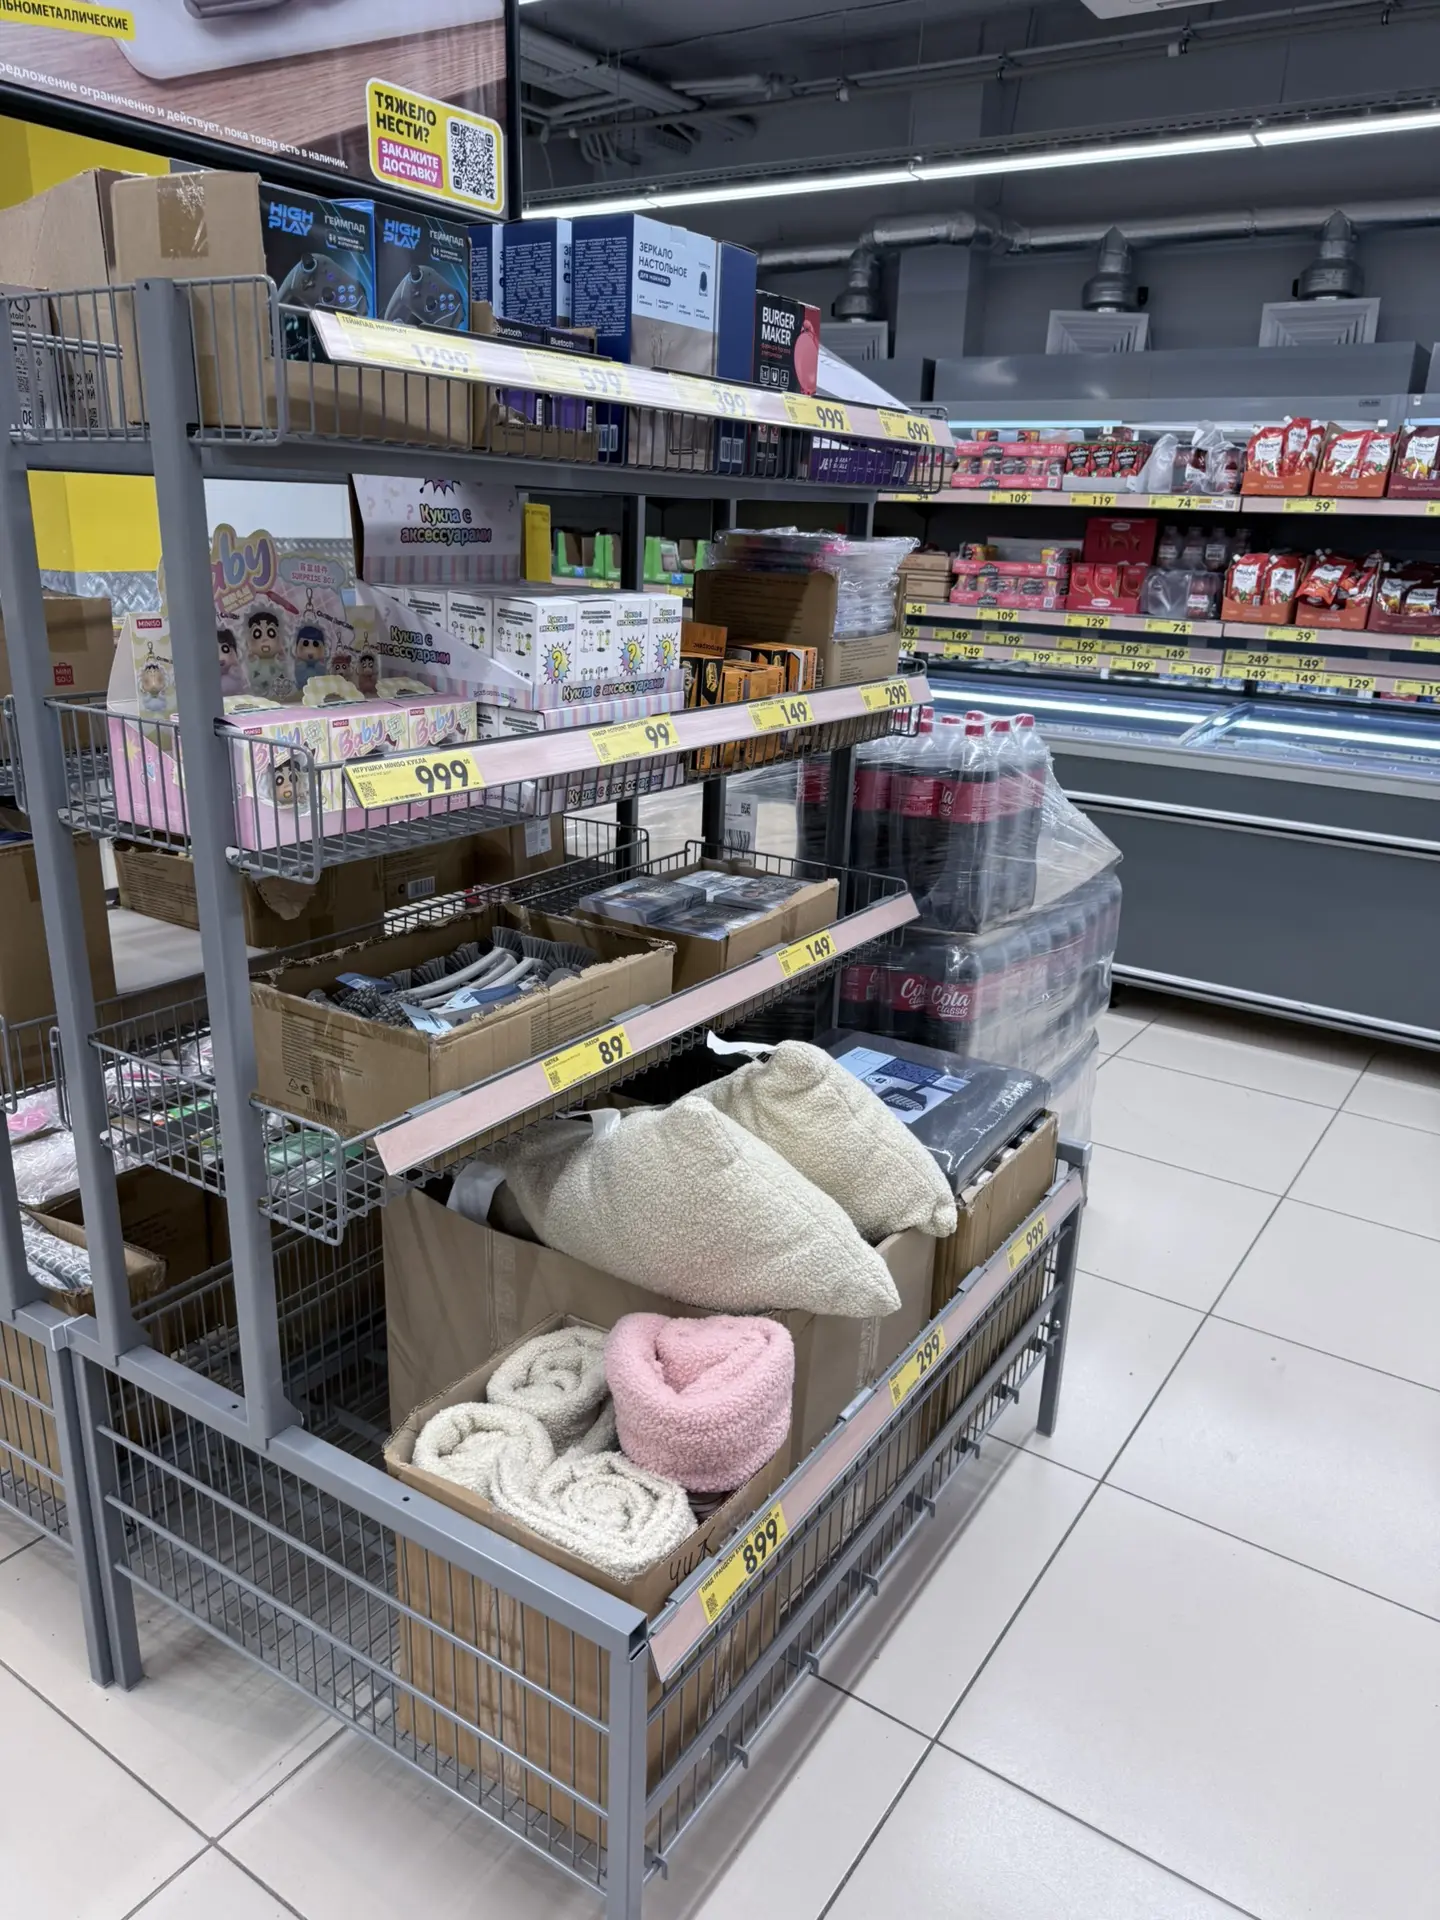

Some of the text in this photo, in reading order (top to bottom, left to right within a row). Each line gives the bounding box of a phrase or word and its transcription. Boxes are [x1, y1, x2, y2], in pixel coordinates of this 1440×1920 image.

[375, 90, 437, 127] ТЯЖЕЛО
[80, 83, 155, 115] ограниченно
[157, 107, 166, 117] и
[167, 110, 223, 137] действует,
[224, 127, 249, 142] пока
[250, 134, 279, 152] товар
[279, 142, 301, 157] есть
[302, 148, 308, 158] в
[308, 150, 349, 170] наличии.
[376, 112, 430, 144] НЕСТИ?
[381, 141, 439, 169] ЗАКАЖИТЕ
[383, 157, 438, 184] ДОСТАВКУ
[269, 202, 314, 222] HIGH
[268, 215, 313, 237] PLAY
[324, 215, 366, 235] ГЕЙМПАД
[384, 218, 421, 238] HIGH
[383, 231, 420, 250] PLAY
[429, 230, 464, 248] ГЕЙМПАД
[639, 241, 673, 260] ЗЕРКАЛО
[638, 256, 688, 278] НАСТОЛЬНОЕ
[762, 306, 795, 330] BURGER
[551, 337, 574, 349] Bluetooth
[761, 324, 791, 346] MAKER
[712, 389, 746, 417] 399
[816, 405, 844, 430] 999
[907, 421, 929, 442] 699
[1009, 493, 1027, 503] 109
[1092, 496, 1111, 506] 119
[1178, 498, 1191, 508] 74
[1315, 501, 1330, 512] 59
[419, 503, 472, 526] Кукла с
[400, 527, 492, 546] аксессуарами
[291, 572, 321, 584] SURPRISE
[912, 605, 922, 614] 54
[997, 611, 1014, 621] 109
[137, 619, 161, 628] MINISO
[1086, 617, 1104, 628] 129
[1173, 623, 1186, 633] 74
[390, 625, 423, 645] Кукла
[951, 631, 968, 641] 149
[1003, 635, 1020, 645] 199
[1296, 631, 1311, 642] 59
[964, 646, 980, 656] 149
[1077, 641, 1094, 651] 199
[1121, 645, 1139, 655] 199
[1166, 649, 1185, 659] 149
[1033, 653, 1050, 663] 199
[1075, 655, 1093, 665] 199
[1131, 661, 1150, 671] 199
[1247, 654, 1269, 665] 249
[1299, 658, 1319, 670] 149
[1192, 665, 1211, 676] 149
[1246, 669, 1266, 679] 149
[1295, 673, 1315, 684] 149
[562, 676, 665, 703] Кукла с аксессуарами
[1348, 678, 1369, 689] 129
[885, 685, 907, 706] 299
[780, 701, 807, 724] 149
[415, 707, 456, 747] Baby
[645, 723, 670, 749] 99
[337, 719, 384, 757] Baby
[352, 757, 427, 775] ИГРУШКИ MINISO КУКЛА
[415, 760, 468, 794] 999
[806, 936, 830, 962] 149
[901, 978, 927, 998] Col
[931, 985, 971, 1007] Cola
[937, 1004, 968, 1015] classic
[598, 1035, 623, 1065] 89
[1026, 1220, 1043, 1251] 999
[917, 1334, 940, 1375] 299
[743, 1518, 778, 1574] 899
